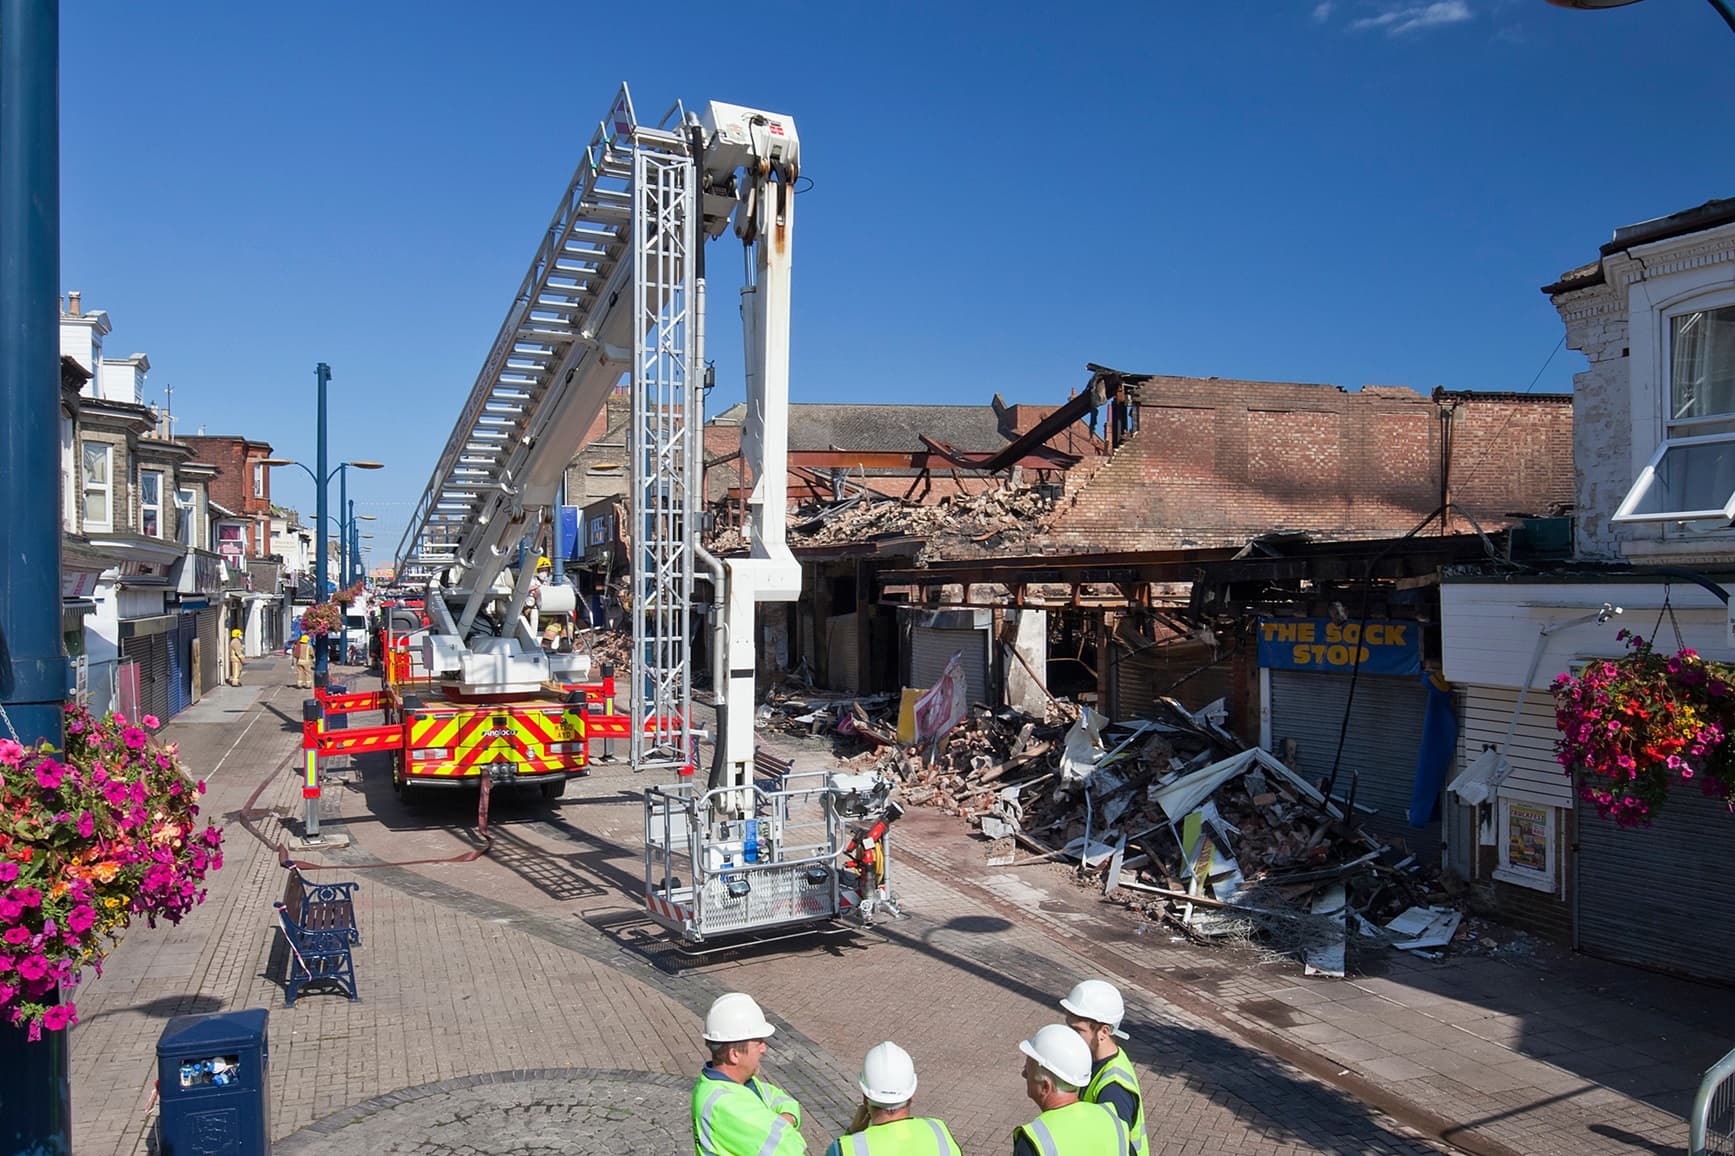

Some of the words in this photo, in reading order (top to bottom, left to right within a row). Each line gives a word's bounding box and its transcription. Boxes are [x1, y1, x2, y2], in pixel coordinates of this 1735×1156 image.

[1262, 622, 1316, 642] THE
[1325, 623, 1407, 646] SOCK
[1293, 644, 1370, 665] STOP
